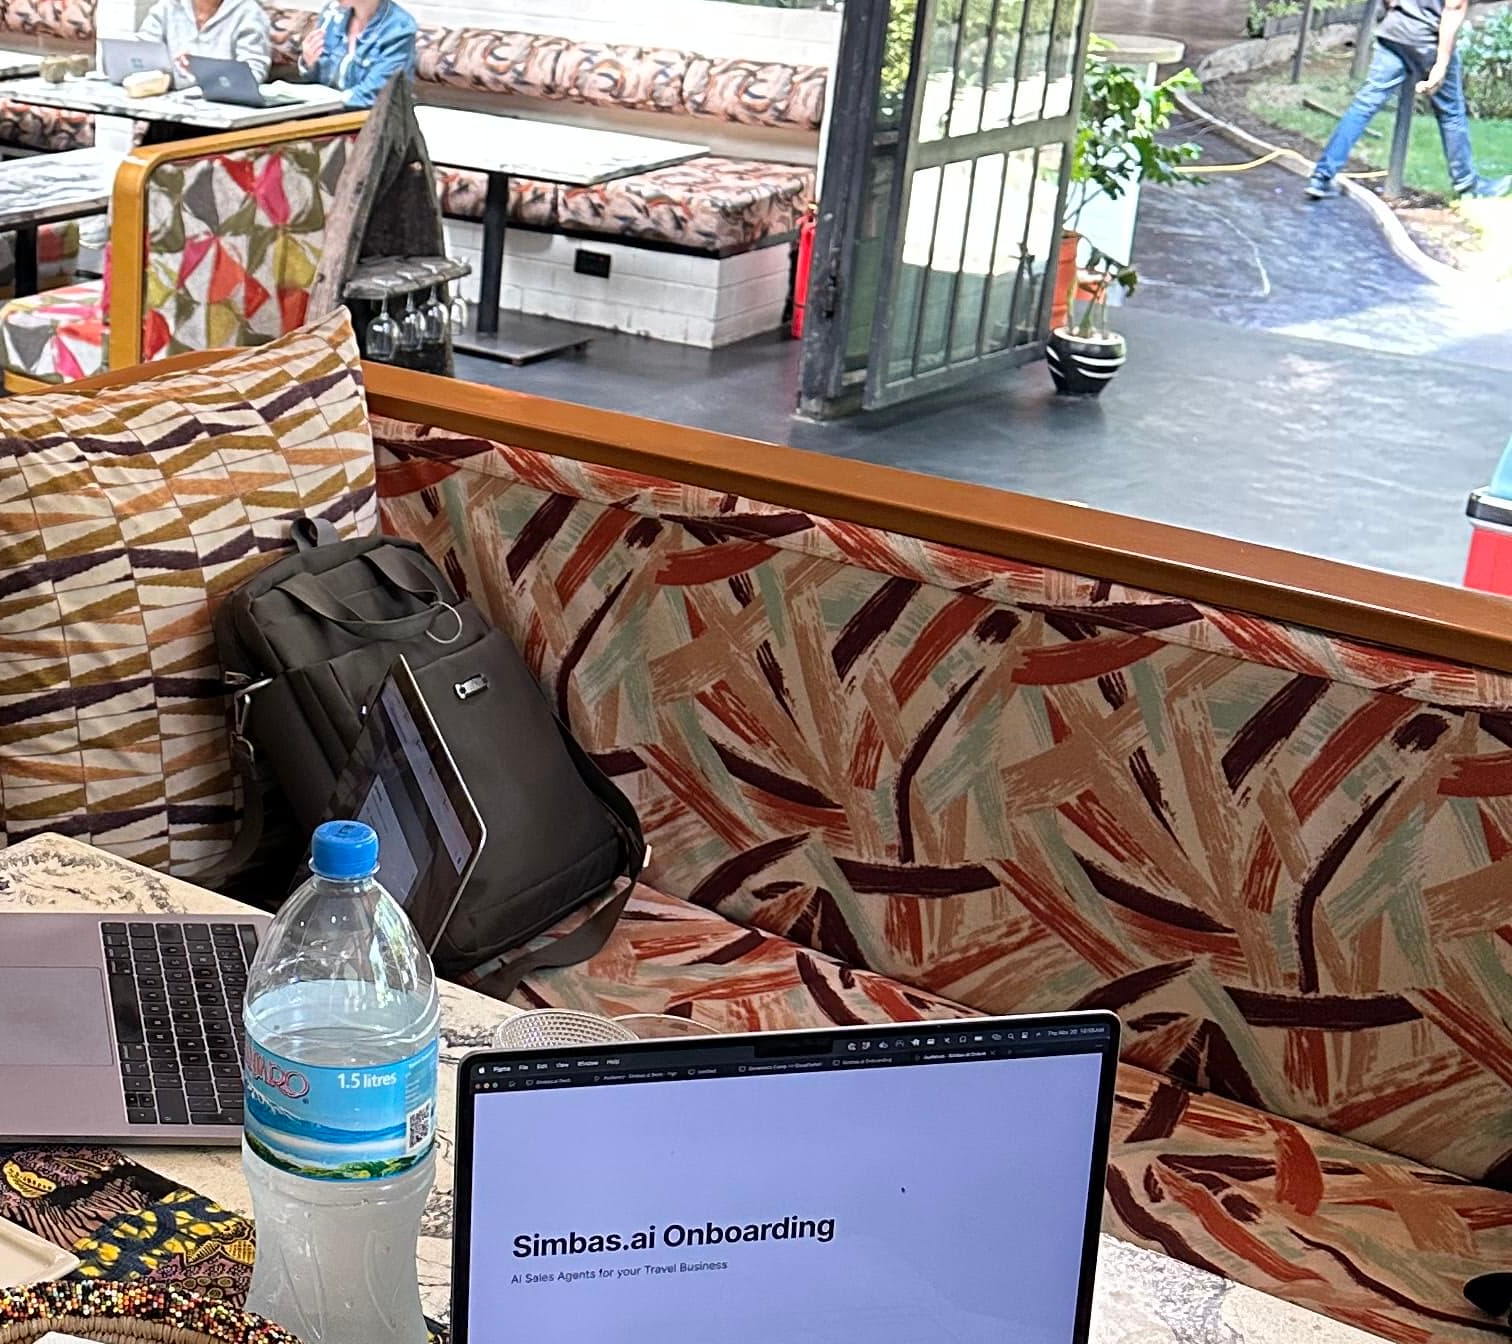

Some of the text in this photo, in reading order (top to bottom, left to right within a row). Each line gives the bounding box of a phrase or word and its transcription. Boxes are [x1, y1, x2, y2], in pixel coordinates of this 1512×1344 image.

[337, 1071, 397, 1089] 1.5 litres
[512, 1215, 835, 1258] Simbas.ai Onboarding
[511, 1259, 729, 1285] AI Sales Agents for your Travel Business
